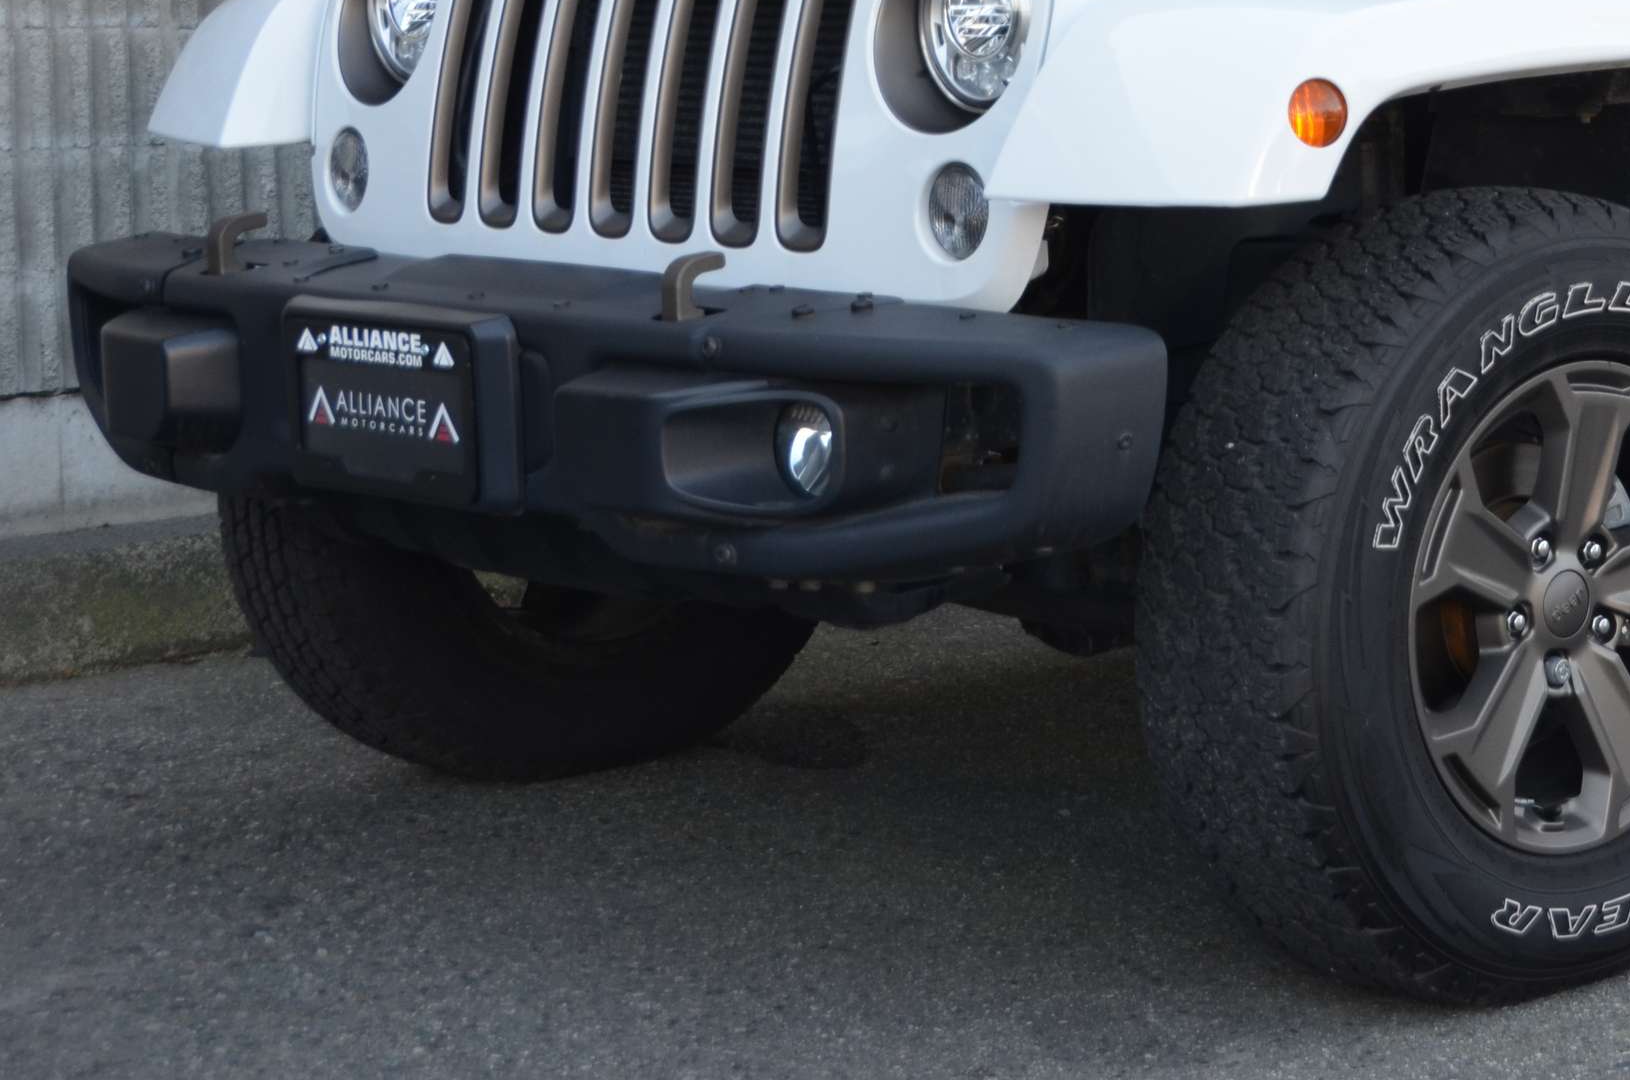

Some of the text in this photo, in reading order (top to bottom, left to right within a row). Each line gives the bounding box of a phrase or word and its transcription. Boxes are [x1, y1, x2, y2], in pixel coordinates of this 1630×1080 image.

[329, 325, 422, 354] ALLIANCE
[329, 346, 423, 368] MOTORCARS.COM
[336, 389, 427, 424] ALLIANCE
[340, 417, 425, 438] MOTORCARS
